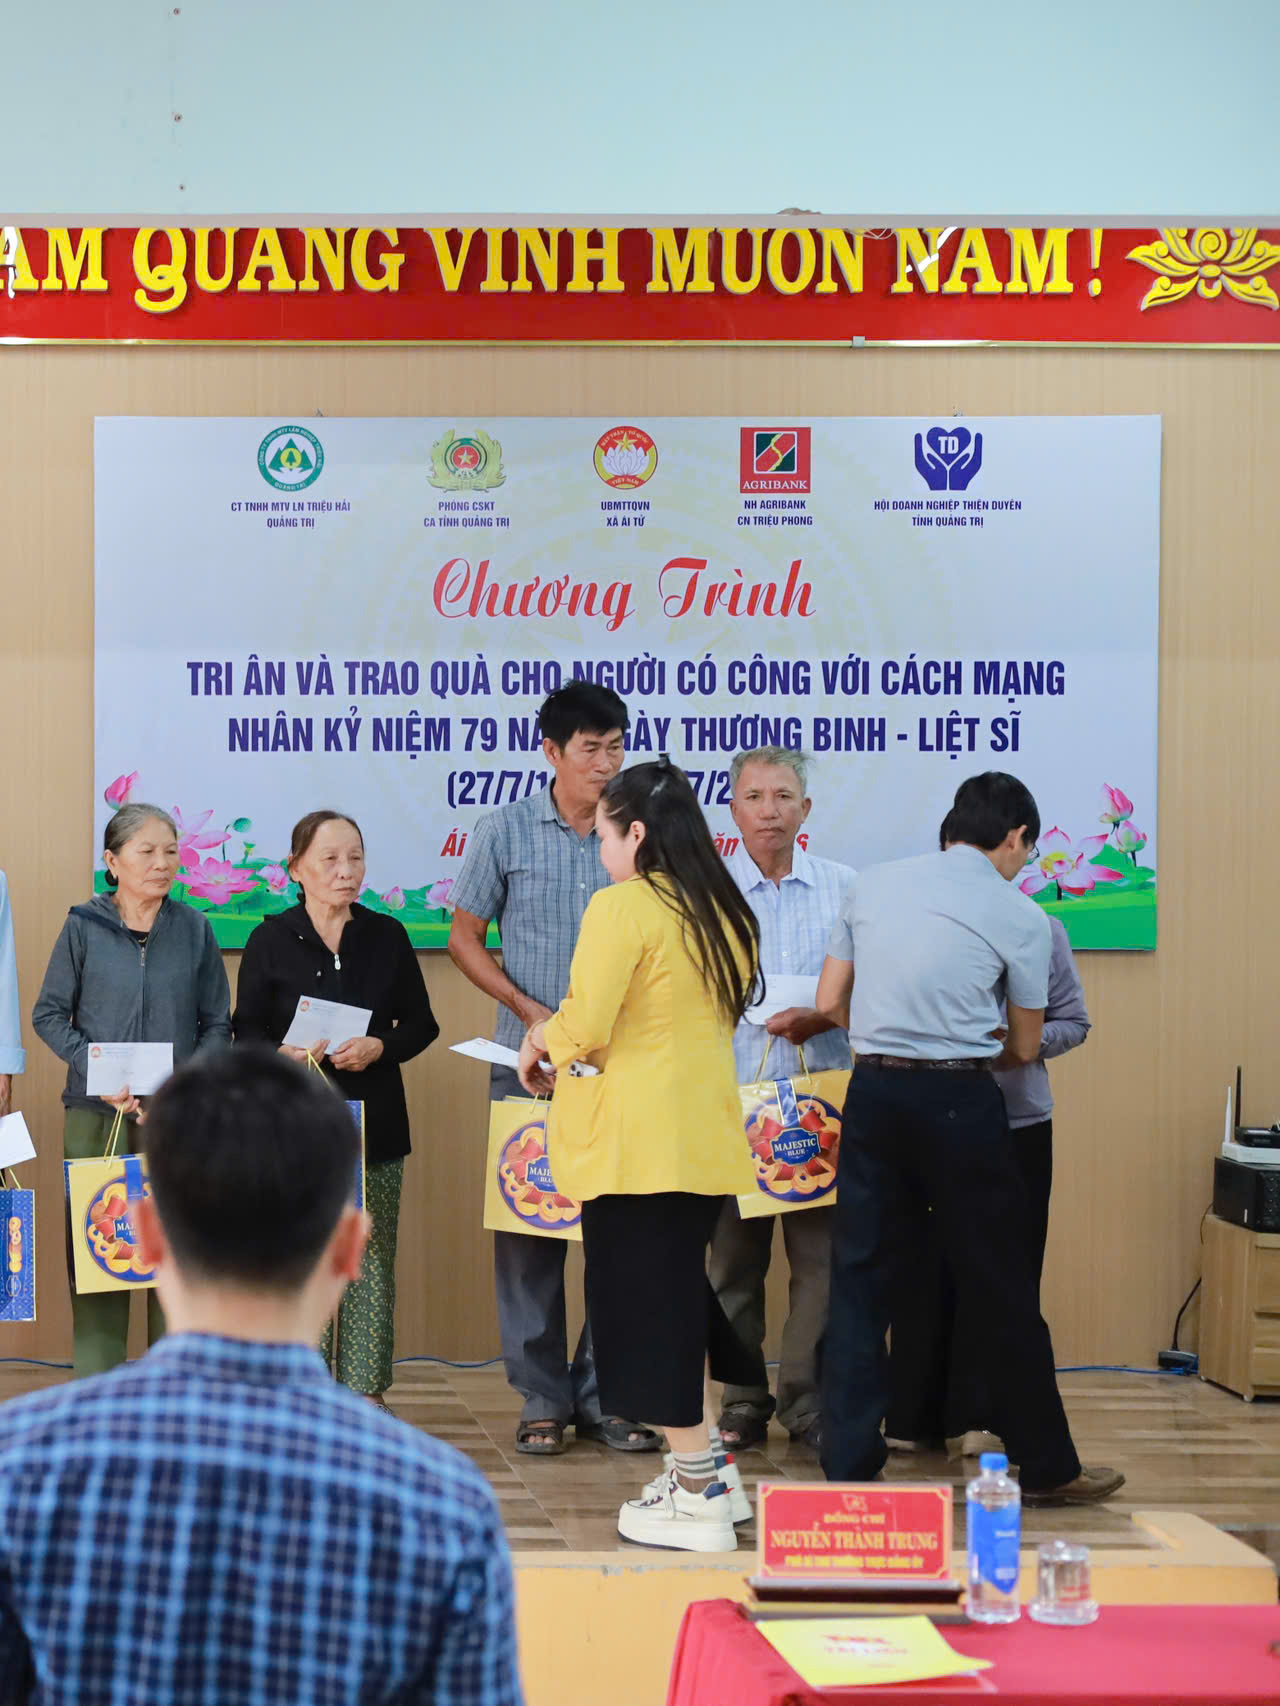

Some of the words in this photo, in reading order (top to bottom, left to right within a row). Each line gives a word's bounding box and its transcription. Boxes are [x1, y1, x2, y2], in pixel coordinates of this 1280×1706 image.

[132, 228, 406, 314] QUANG
[424, 228, 625, 293] VINH
[938, 436, 959, 454] TD
[743, 480, 808, 489] AGRIBANK
[231, 502, 242, 511] CT
[245, 502, 269, 511] TNHH
[271, 502, 290, 511] MTV
[293, 502, 305, 511] LN
[307, 499, 333, 514] TRIỆU
[438, 500, 470, 511] PHÒNG
[472, 501, 495, 511] CSKT
[601, 501, 650, 511] UBMTTQVN
[744, 500, 757, 509] NH
[760, 500, 806, 509] AGRIBANK
[874, 499, 889, 512] HỘI
[892, 501, 923, 510] DOANH
[926, 499, 960, 512] NGHIỆP
[963, 499, 989, 512] THIỆN
[992, 499, 1022, 510] DUYÊN
[301, 517, 315, 529] TRỊ
[424, 517, 436, 527] CA
[496, 517, 510, 529] TRỊ
[737, 516, 750, 525] CN
[753, 514, 779, 527] TRIỆU
[781, 516, 813, 525] PHONG
[969, 517, 984, 528] TRỊ
[433, 557, 635, 632] Chương
[658, 557, 817, 618] Trình
[187, 661, 232, 696] TRI
[243, 654, 285, 696] ÂN
[296, 653, 335, 696] VÀ
[344, 661, 419, 696] TRAO
[430, 653, 491, 699] QUÀ
[501, 660, 562, 696] CHO
[677, 653, 717, 696] CÓ
[728, 653, 811, 696] CÔNG
[821, 653, 870, 696] VỚI
[881, 653, 963, 696] CÁCH
[973, 660, 1066, 703] MẠNG
[228, 710, 313, 752] NHÂN
[324, 705, 362, 752] KỶ
[372, 710, 451, 760] NIỆM
[461, 717, 498, 752] 79
[681, 714, 803, 752] THƯƠNG
[813, 717, 886, 752] BINH
[919, 710, 980, 760] LIỆT
[990, 710, 1022, 752] SĨ
[440, 827, 468, 857] Ái
[774, 1138, 817, 1153] MAJESTIC
[887, 1531, 938, 1550] TRUNG
